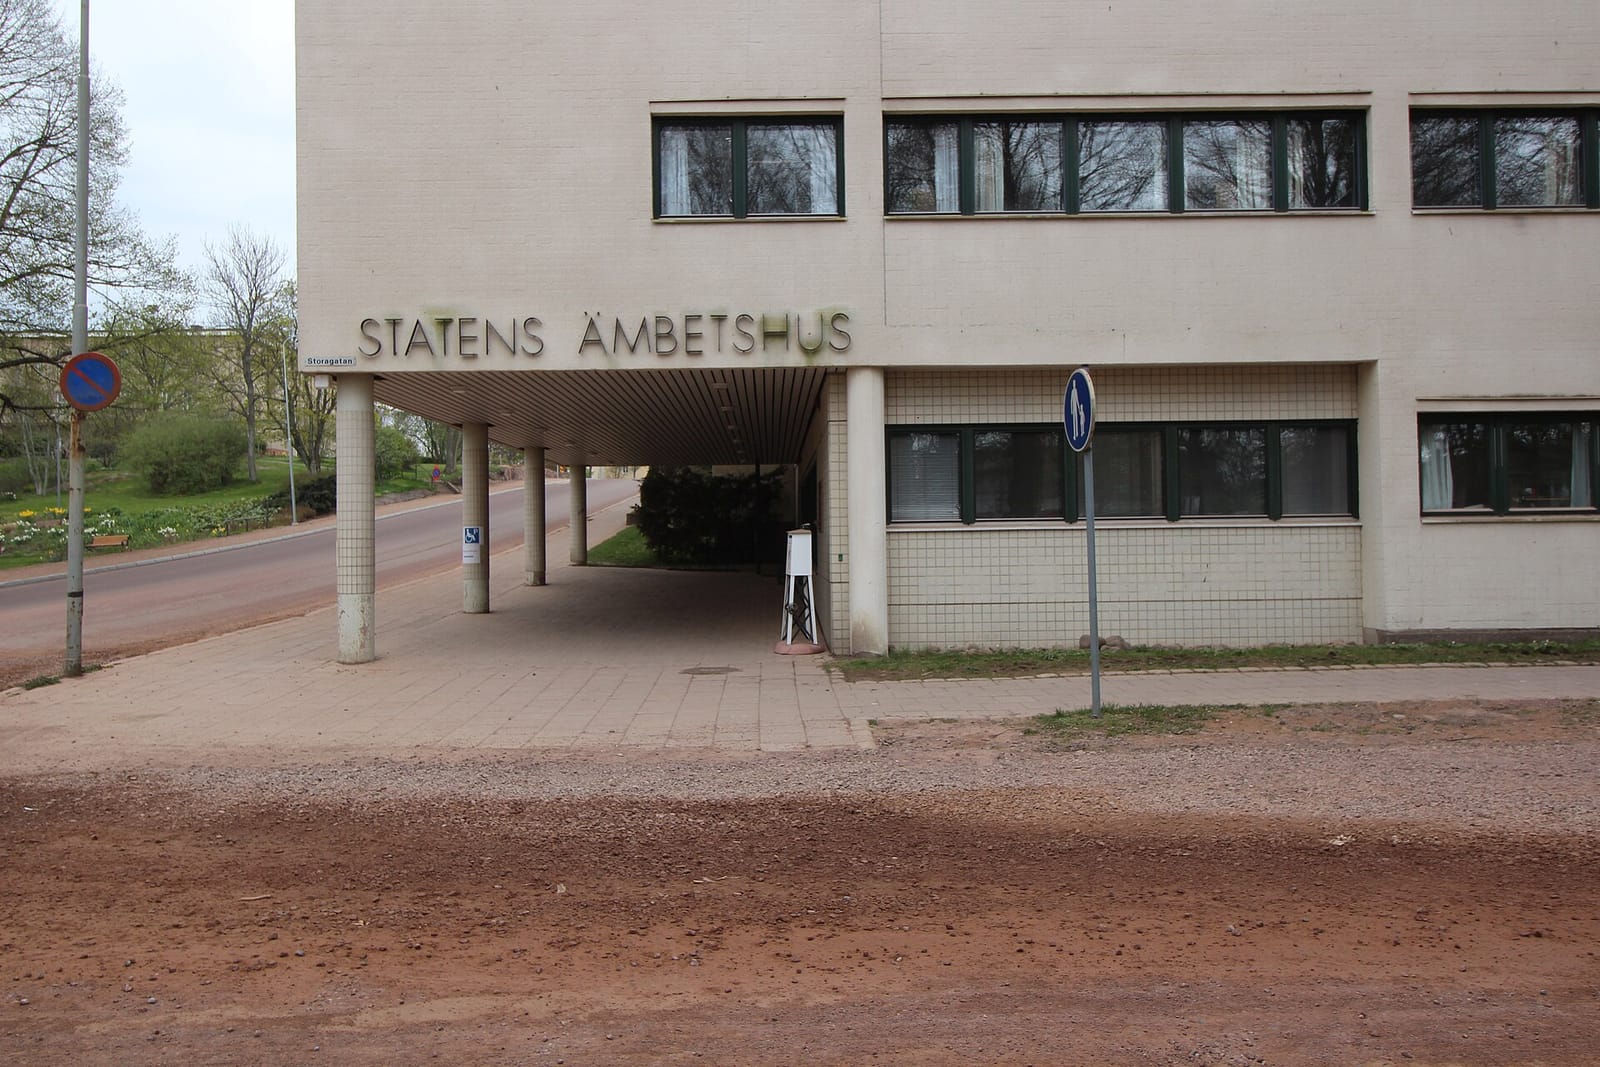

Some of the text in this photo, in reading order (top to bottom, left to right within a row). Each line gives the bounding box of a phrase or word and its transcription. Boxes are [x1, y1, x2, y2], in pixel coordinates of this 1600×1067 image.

[358, 310, 851, 357] STATENS ÄMBETSHUS
[307, 357, 353, 366] Storagatan
